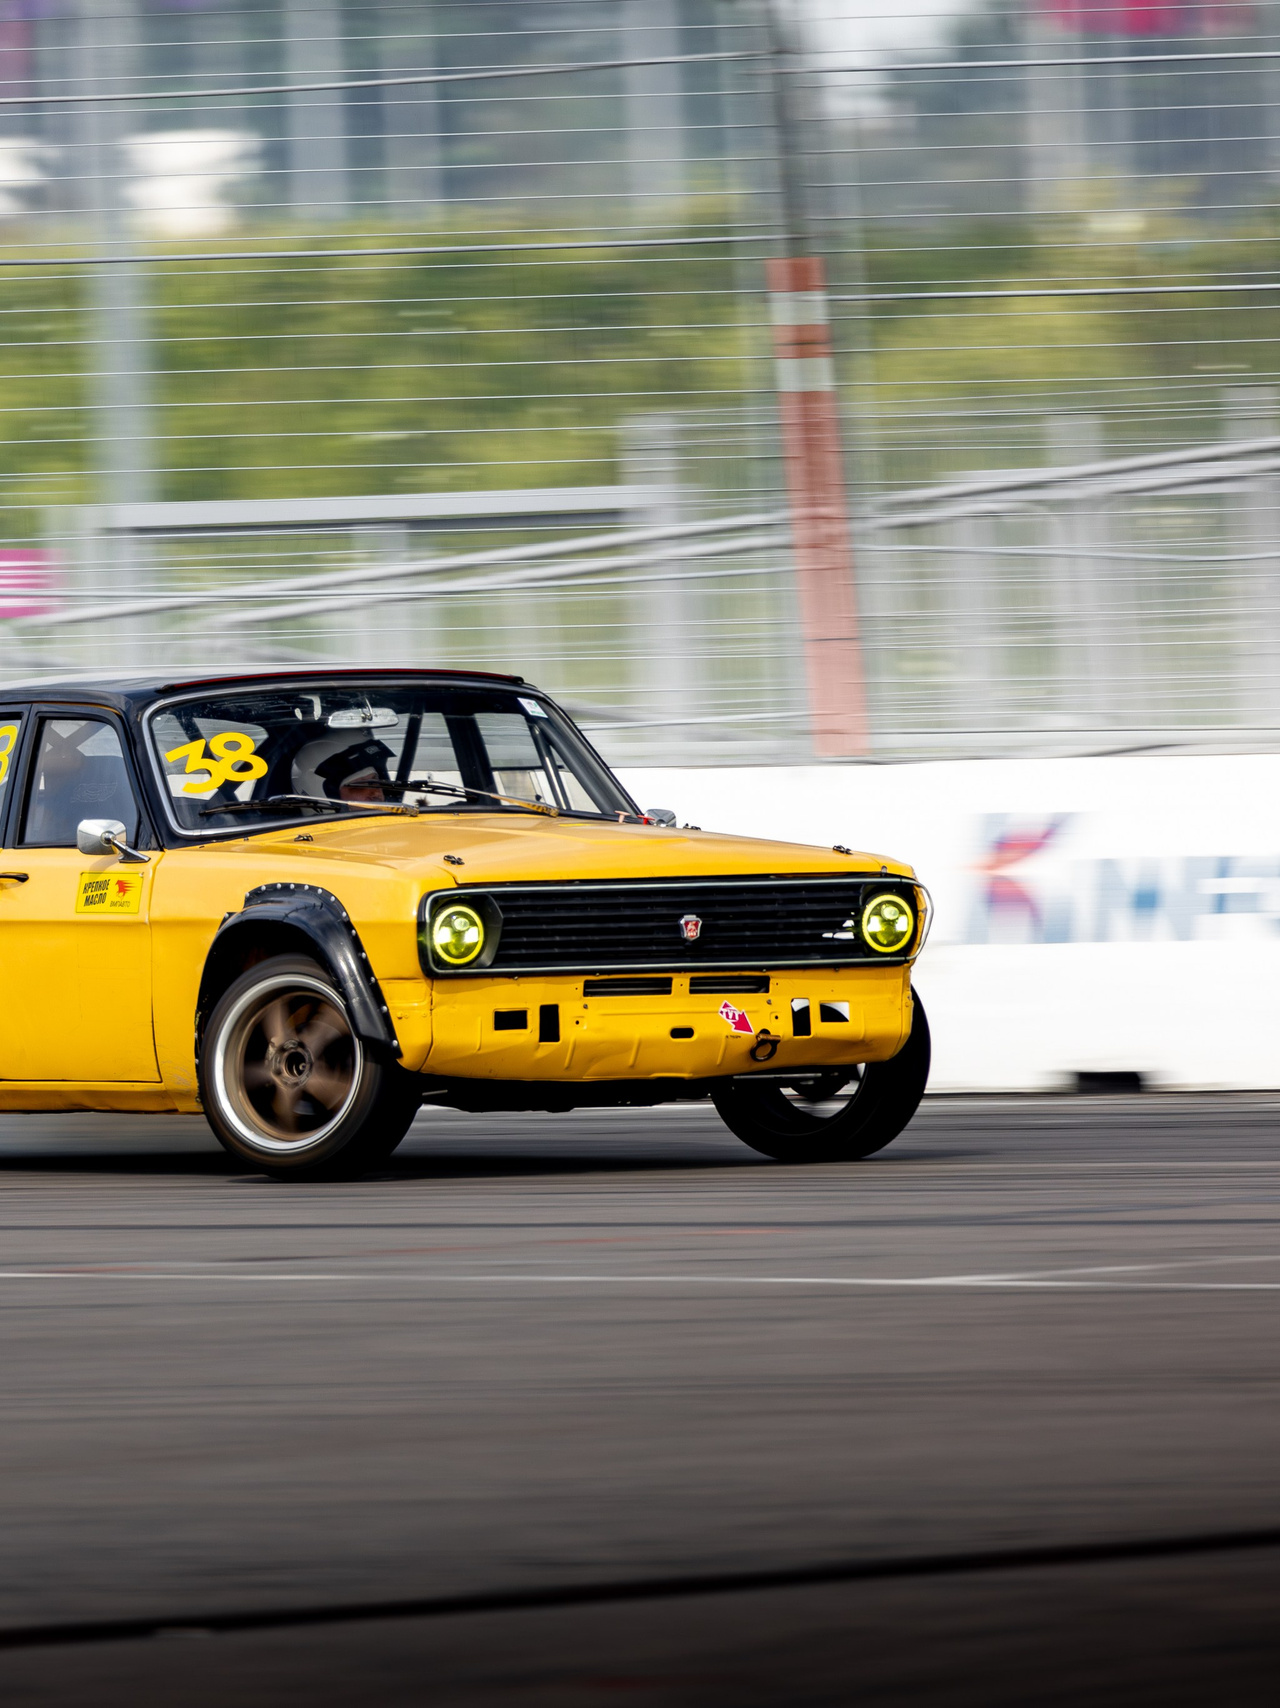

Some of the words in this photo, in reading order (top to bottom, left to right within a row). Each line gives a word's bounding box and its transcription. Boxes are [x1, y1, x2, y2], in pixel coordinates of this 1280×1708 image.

[165, 732, 268, 793] 38
[83, 879, 111, 894] КРЕПКОЕ
[84, 892, 107, 907] МАСЛО
